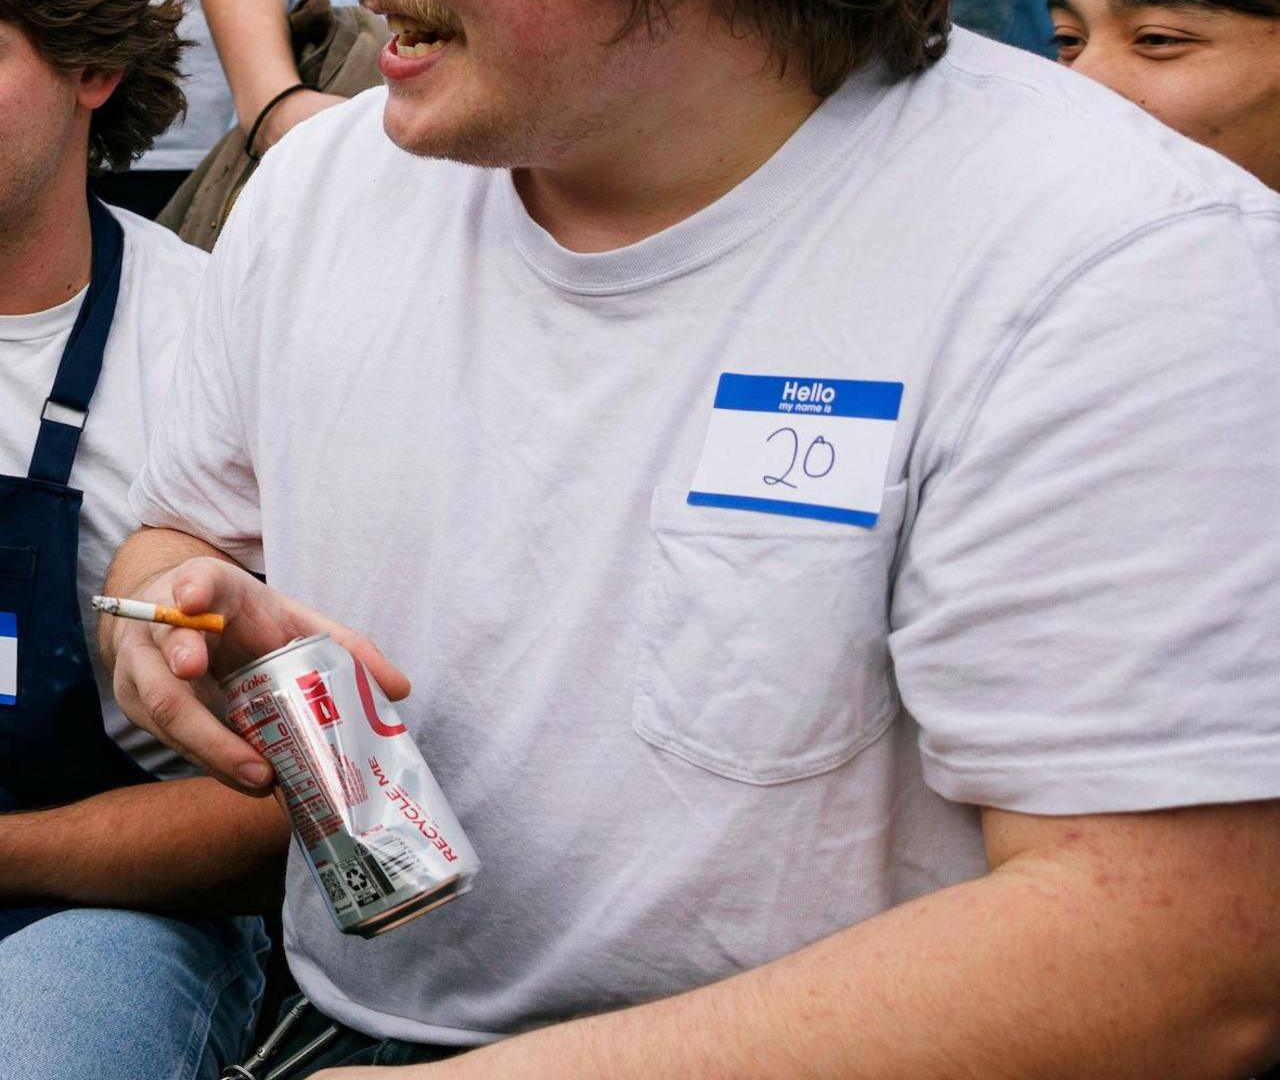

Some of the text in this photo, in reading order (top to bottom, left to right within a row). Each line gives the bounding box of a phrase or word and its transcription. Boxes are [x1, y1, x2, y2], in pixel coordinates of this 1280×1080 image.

[782, 381, 835, 403] Hello
[763, 427, 835, 489] 20
[277, 722, 289, 737] 0
[367, 755, 389, 787] ME
[384, 788, 458, 862] RECYCLE
